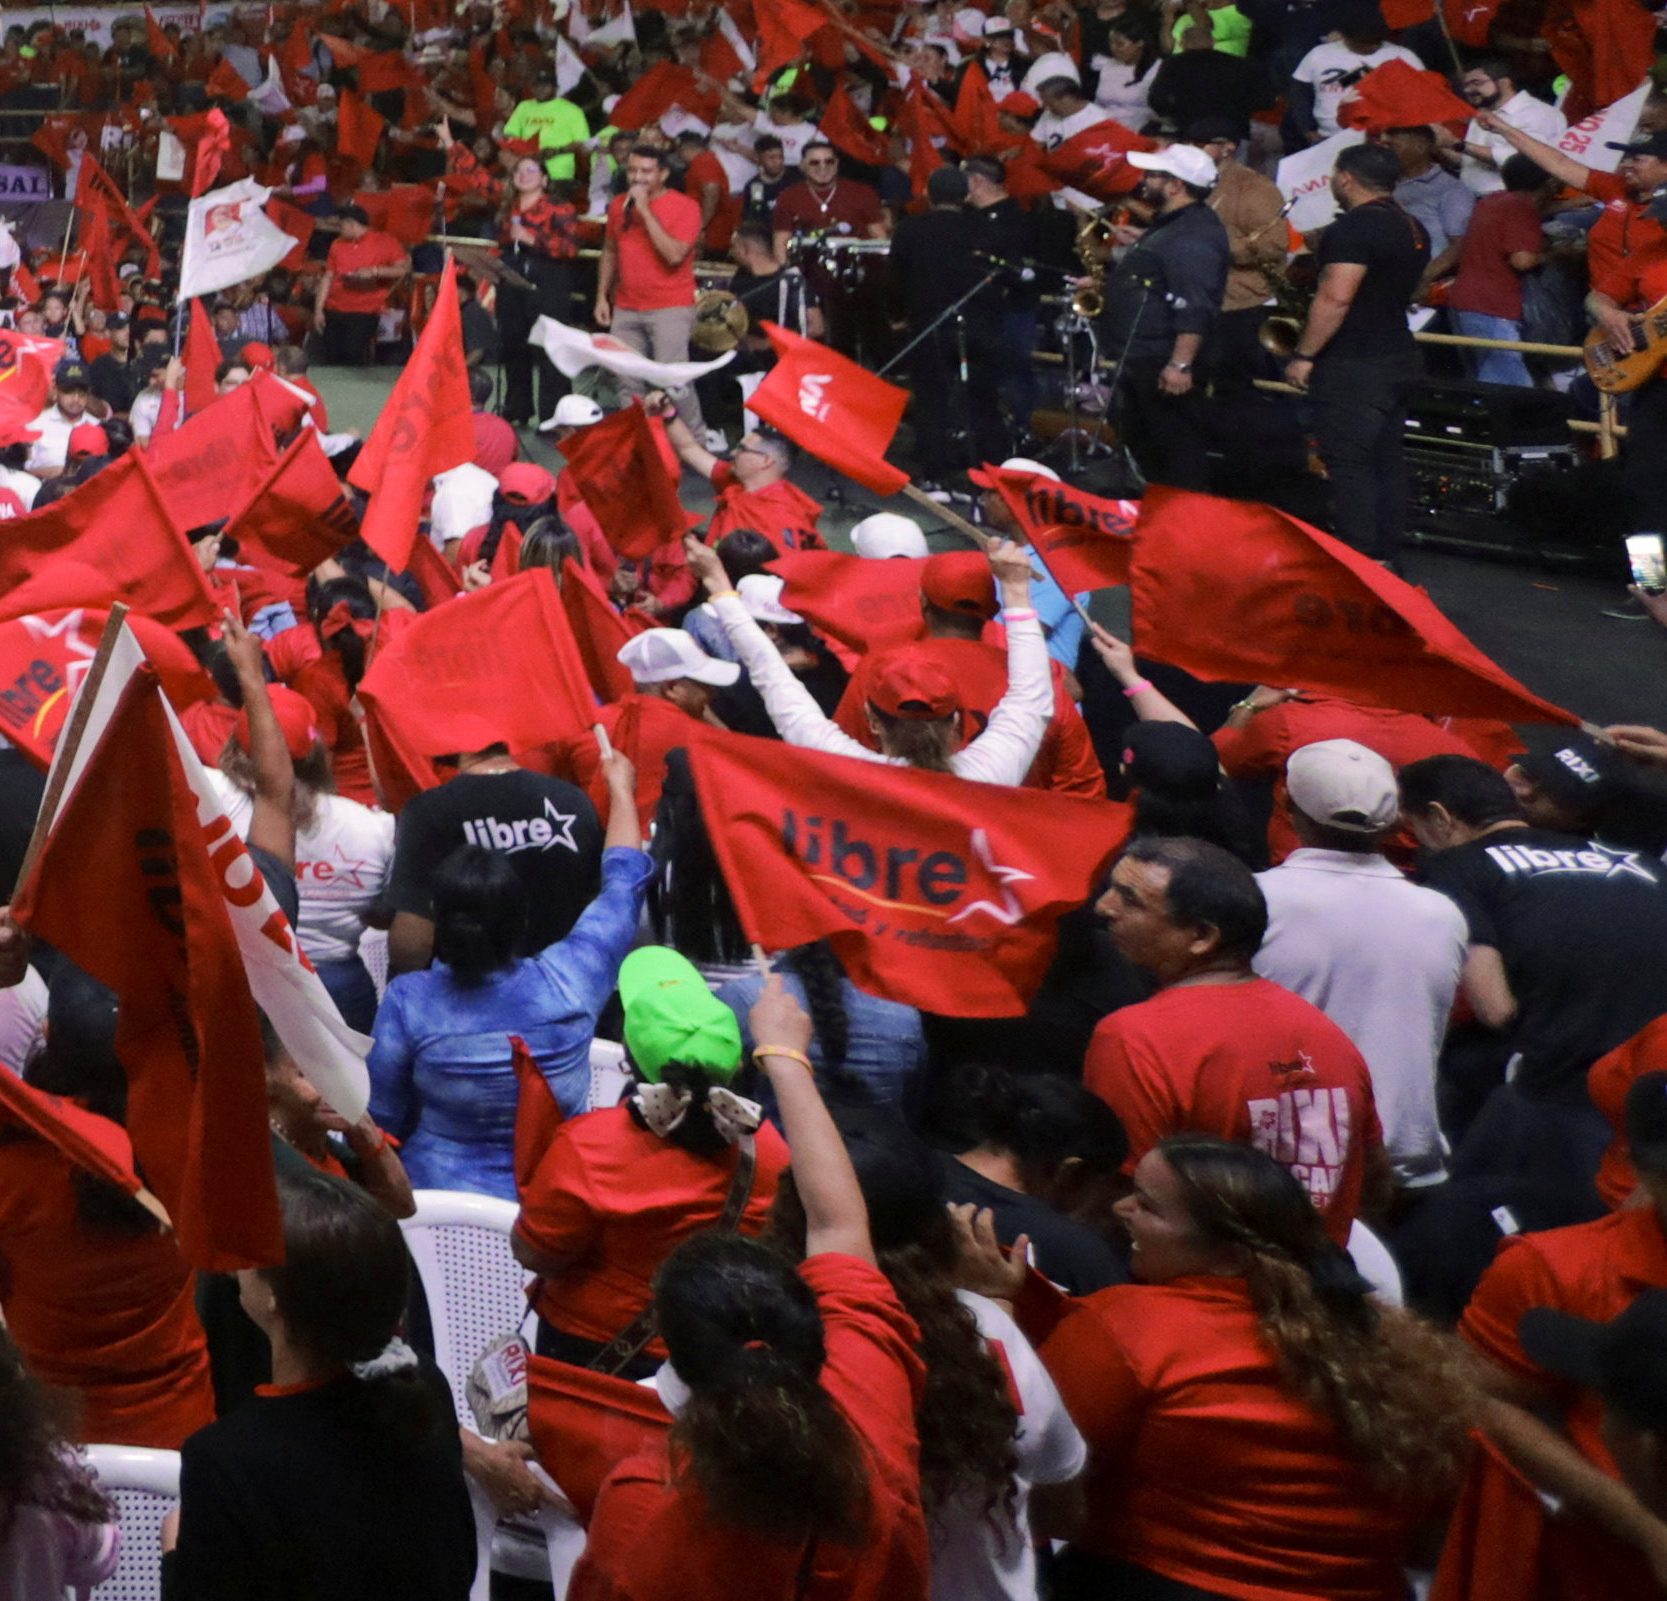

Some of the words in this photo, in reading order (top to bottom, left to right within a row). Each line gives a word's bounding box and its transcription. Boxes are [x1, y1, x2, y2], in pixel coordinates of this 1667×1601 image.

[1023, 486, 1137, 537] libre
[1553, 747, 1602, 784] RIXI
[463, 816, 553, 851] libre
[782, 808, 970, 906] libre
[1484, 844, 1612, 879] libre
[1248, 1086, 1351, 1167] RIXI
[500, 1343, 528, 1387] RIXI
